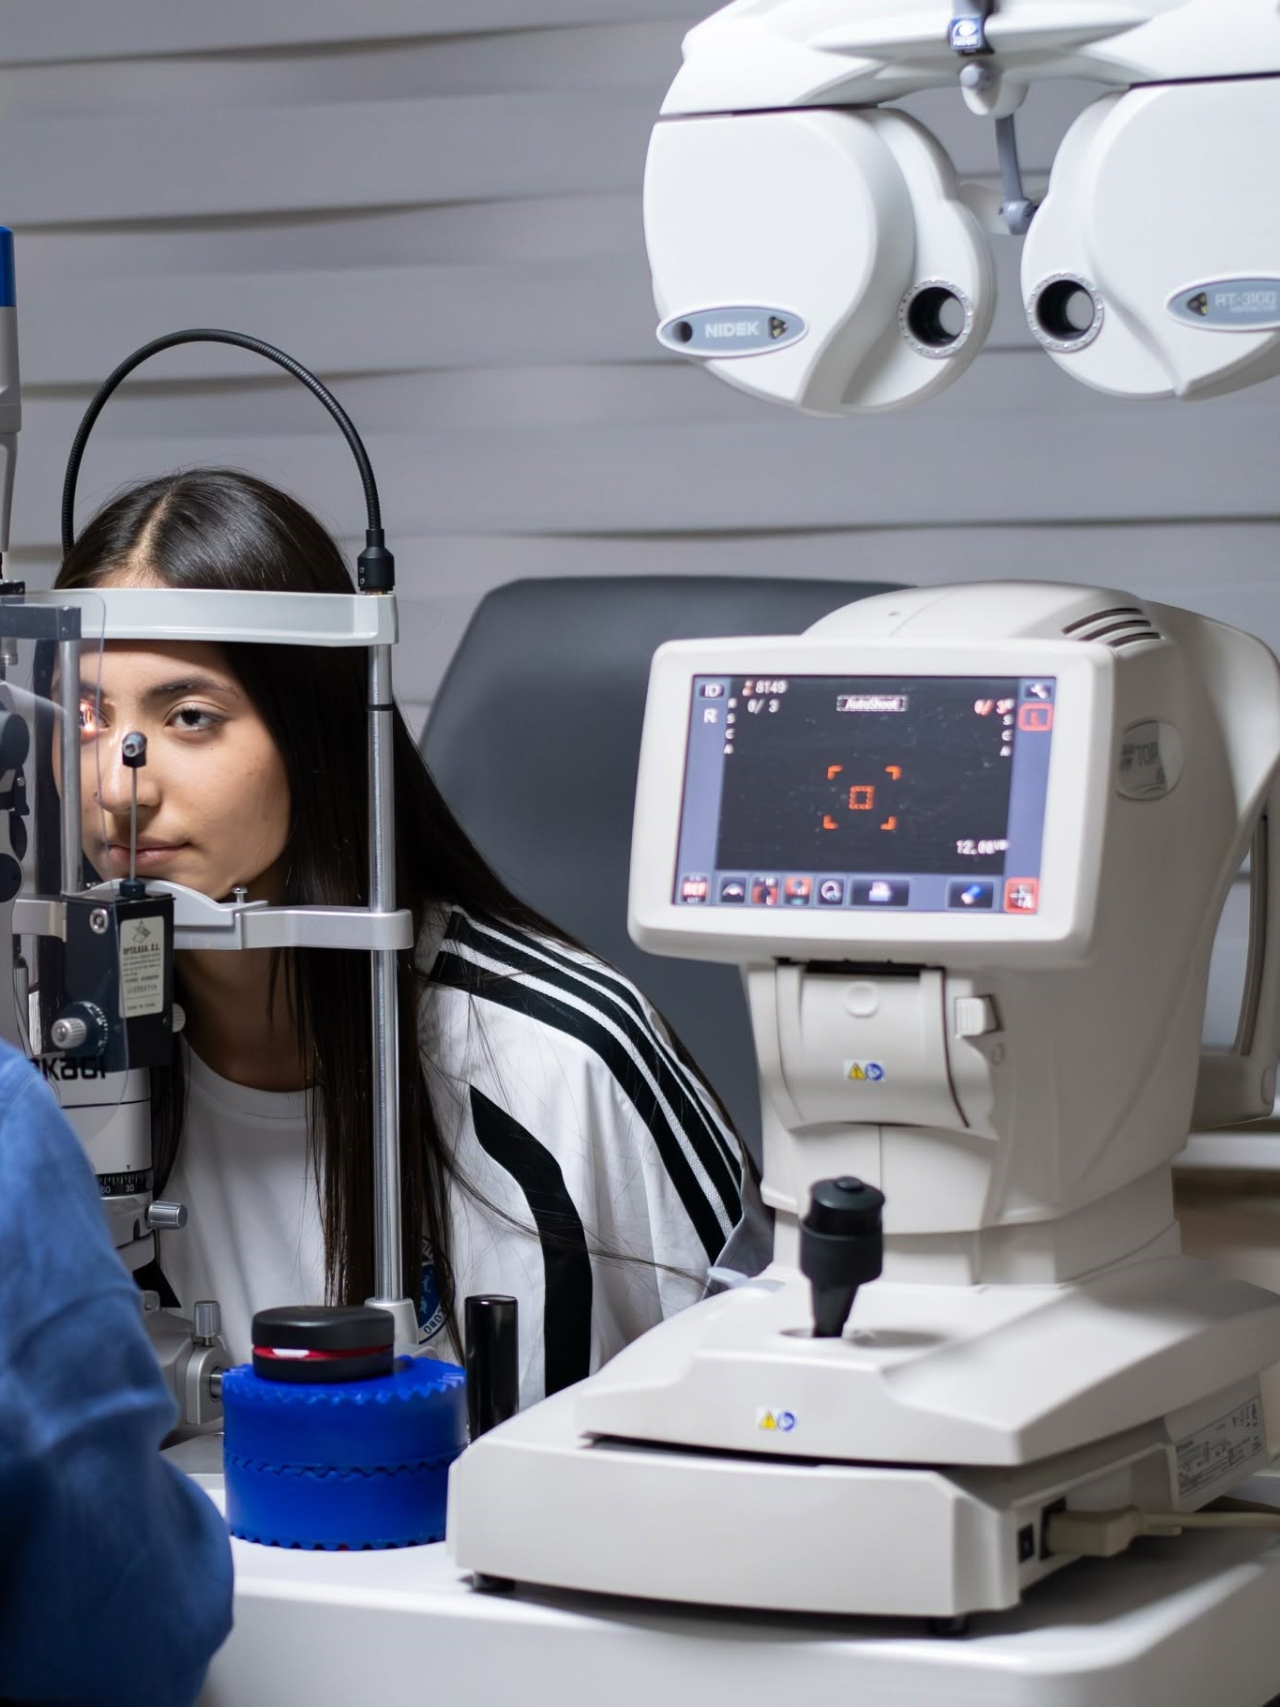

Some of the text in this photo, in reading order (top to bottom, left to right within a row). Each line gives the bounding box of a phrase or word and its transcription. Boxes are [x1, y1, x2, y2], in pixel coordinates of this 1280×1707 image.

[705, 322, 760, 338] NIDEK
[705, 684, 721, 697] ID
[704, 708, 718, 723] R
